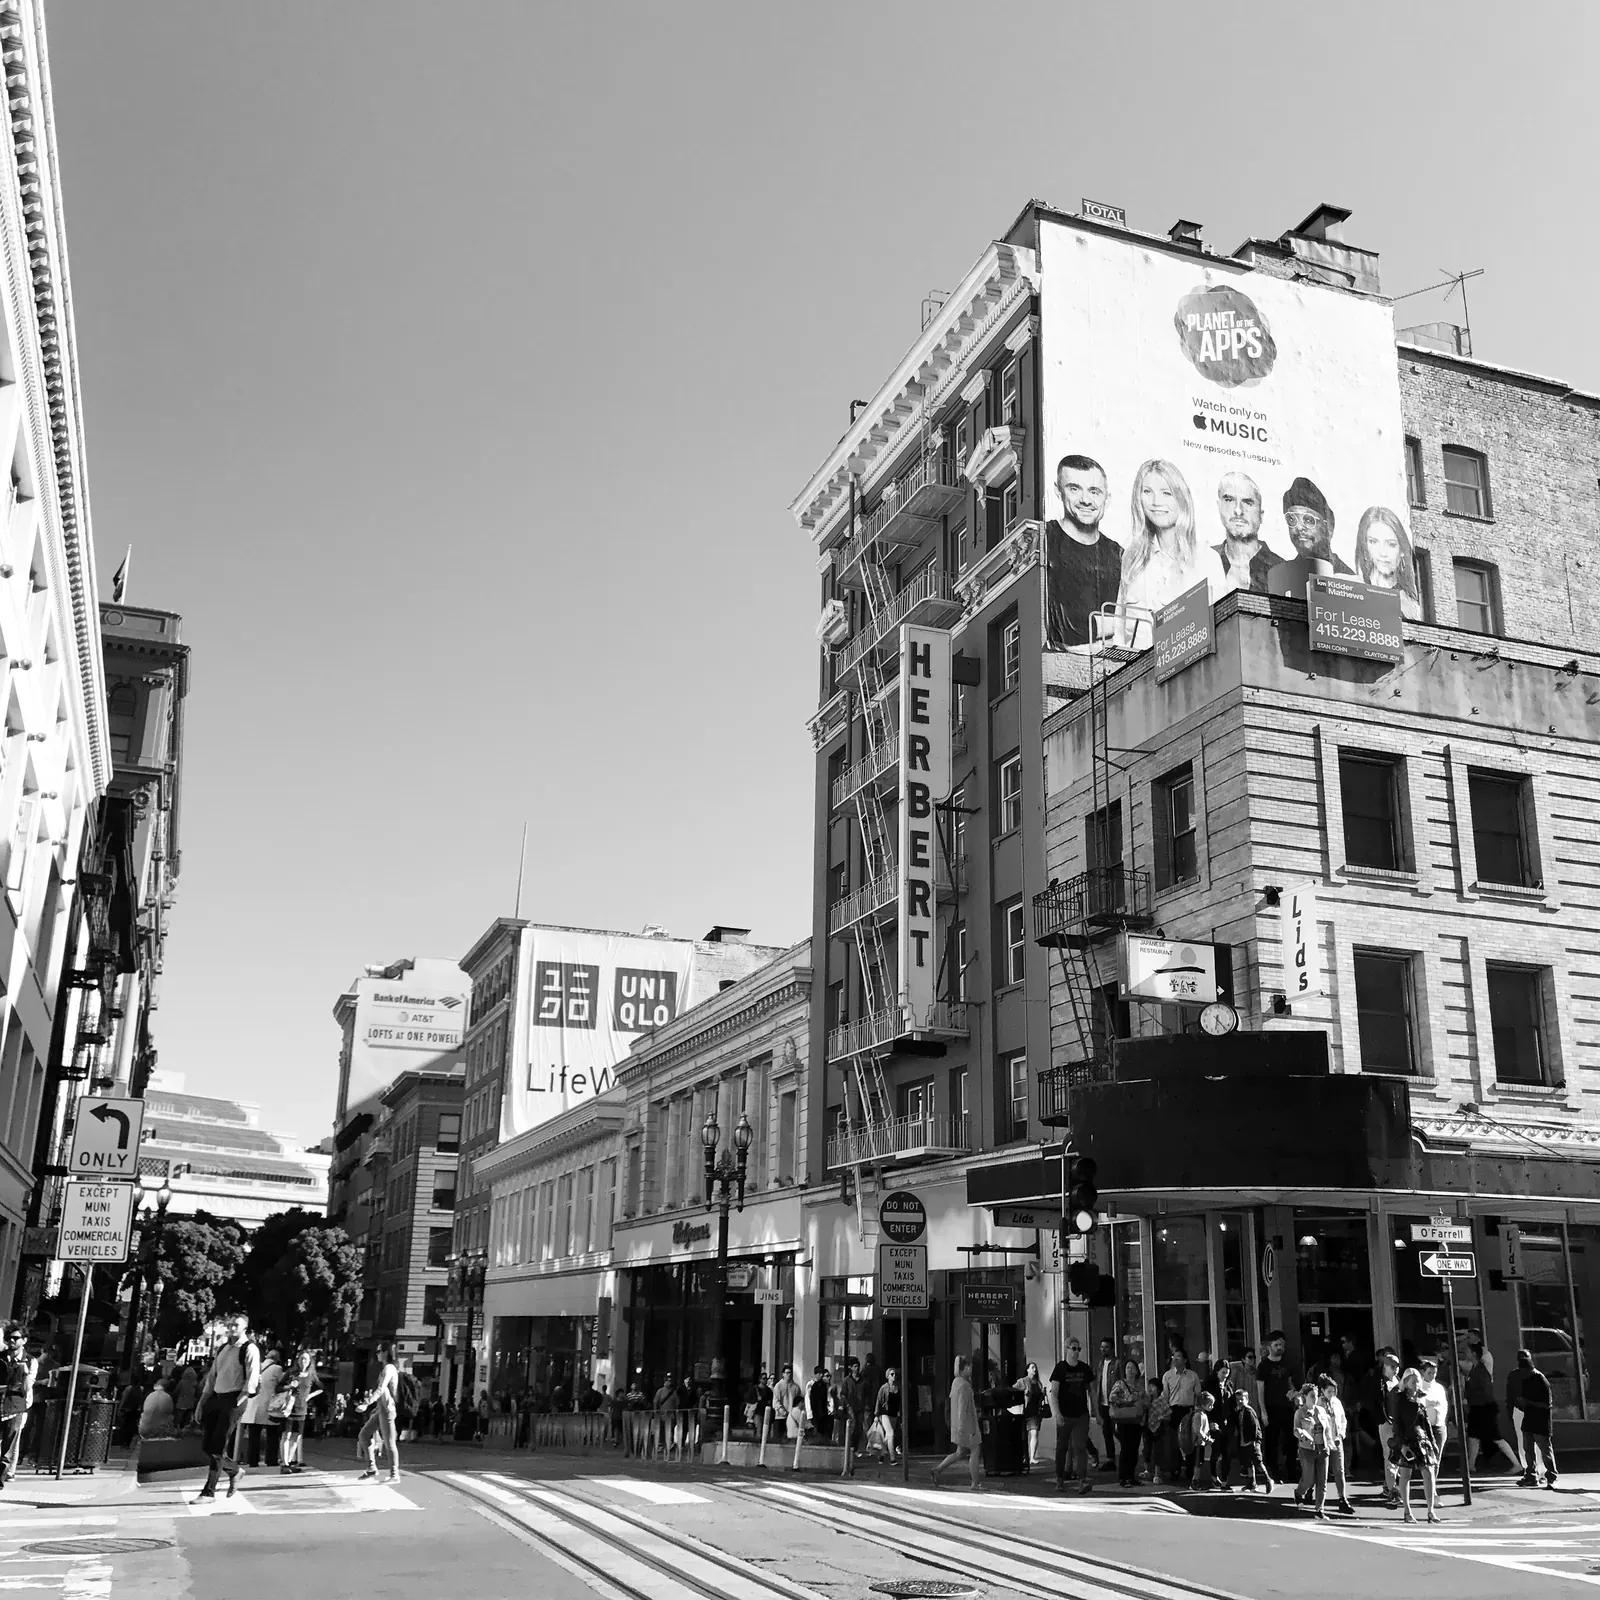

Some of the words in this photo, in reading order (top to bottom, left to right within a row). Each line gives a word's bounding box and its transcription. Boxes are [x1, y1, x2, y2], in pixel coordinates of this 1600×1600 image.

[1083, 202, 1124, 222] TOTAL
[1187, 310, 1236, 332] PLANET
[1236, 319, 1243, 328] OF
[1243, 318, 1255, 327] THE
[1199, 327, 1262, 362] APPS
[1192, 397, 1227, 413] Watch
[1229, 407, 1251, 420] only
[1253, 412, 1267, 421] on
[1210, 418, 1268, 442] MUSIC
[1183, 439, 1202, 450] New
[1203, 444, 1241, 457] episodes
[1327, 580, 1353, 591] Kidder
[1328, 588, 1364, 600] Mathews
[1315, 606, 1338, 622] For
[1341, 611, 1380, 630] Lease
[1156, 638, 1169, 654] For
[1170, 622, 1196, 645] Lease
[1316, 622, 1400, 648] 415.229.8888
[1156, 627, 1208, 668] 415.229.8888
[1316, 642, 1331, 650] STAN
[1331, 645, 1348, 653] COHN
[1364, 650, 1388, 660] CLAYTON
[909, 641, 931, 968] HERBERT
[1292, 895, 1308, 992] Lids
[1139, 947, 1173, 955] RESTAURANT
[621, 975, 666, 1000] UNI
[373, 993, 395, 1002] Bank
[395, 994, 403, 1003] of
[403, 995, 435, 1006] America
[411, 1014, 434, 1023] AT&T
[620, 1002, 669, 1028] QLO
[368, 1028, 393, 1040] LOFTS
[396, 1032, 404, 1040] AT
[407, 1031, 424, 1041] ONE
[428, 1032, 459, 1044] POWELL
[79, 1151, 128, 1168] ONLY
[79, 1187, 119, 1198] EXCEPT
[84, 1202, 111, 1212] MUNI
[886, 1201, 898, 1210] DO
[903, 1201, 919, 1210] NOT
[82, 1216, 111, 1227] TAXIS
[1012, 1212, 1034, 1224] Lids
[1433, 1217, 1444, 1225] 200
[889, 1224, 917, 1233] ENTER
[1420, 1228, 1463, 1239] O'Farrell
[64, 1230, 123, 1242] COMMERCIAL
[67, 1245, 117, 1256] VEHICLES
[889, 1248, 917, 1257] EXCEPT
[1051, 1229, 1059, 1268] Lids
[1506, 1230, 1516, 1275] Lids
[894, 1261, 912, 1269] MUNI
[1436, 1260, 1452, 1269] ONE
[1454, 1260, 1469, 1269] WAY
[893, 1272, 914, 1280] TAXIS
[882, 1283, 925, 1293] COMMERCIAL
[760, 1293, 779, 1301] JINS
[886, 1295, 922, 1304] VEHICLES
